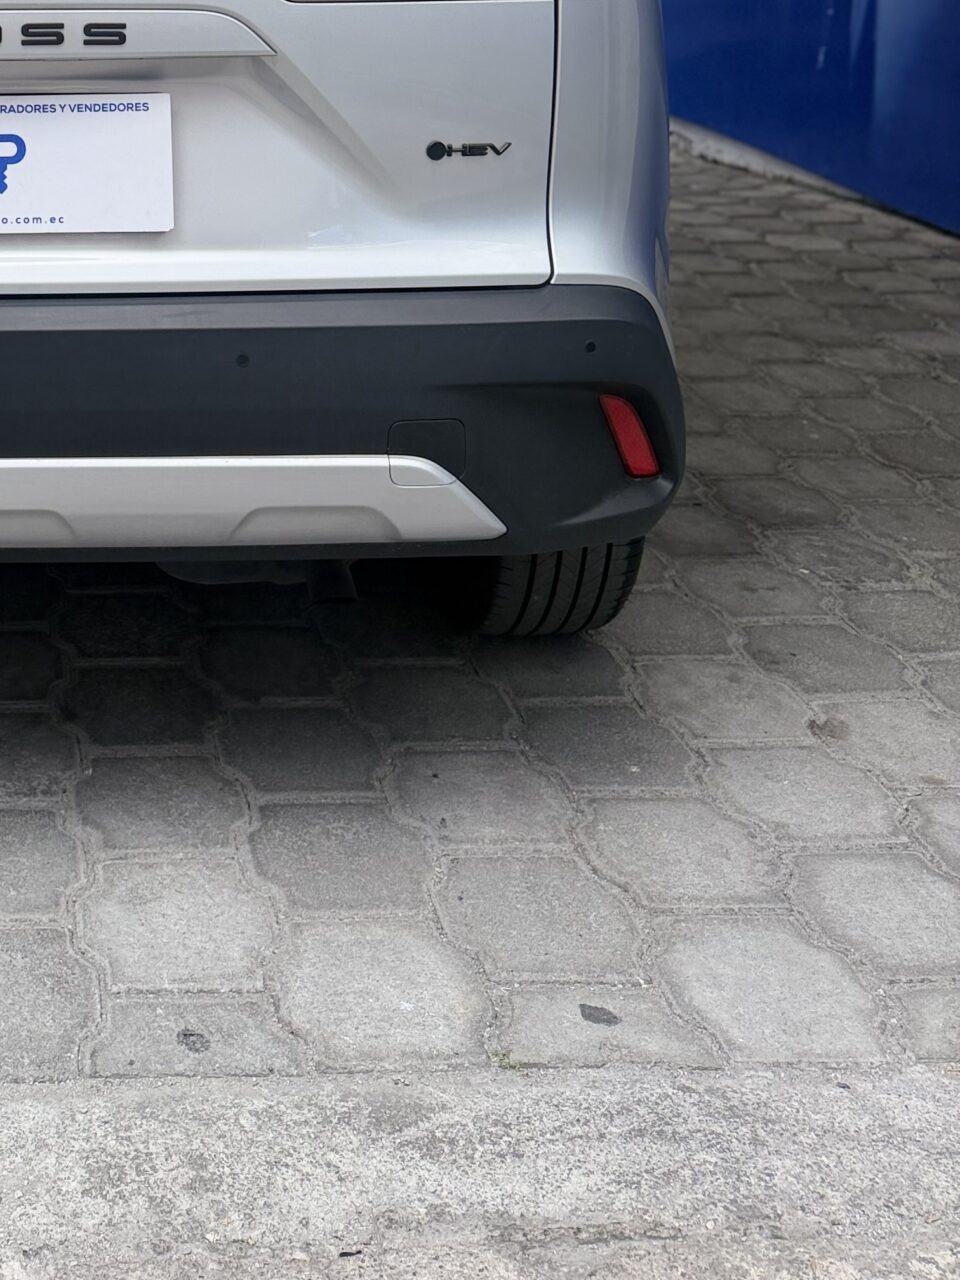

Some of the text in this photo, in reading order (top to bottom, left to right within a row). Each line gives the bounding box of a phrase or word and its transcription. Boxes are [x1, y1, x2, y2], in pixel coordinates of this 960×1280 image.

[58, 103, 67, 113] Y
[68, 102, 150, 113] VENDEDORES
[446, 142, 512, 157] HEV
